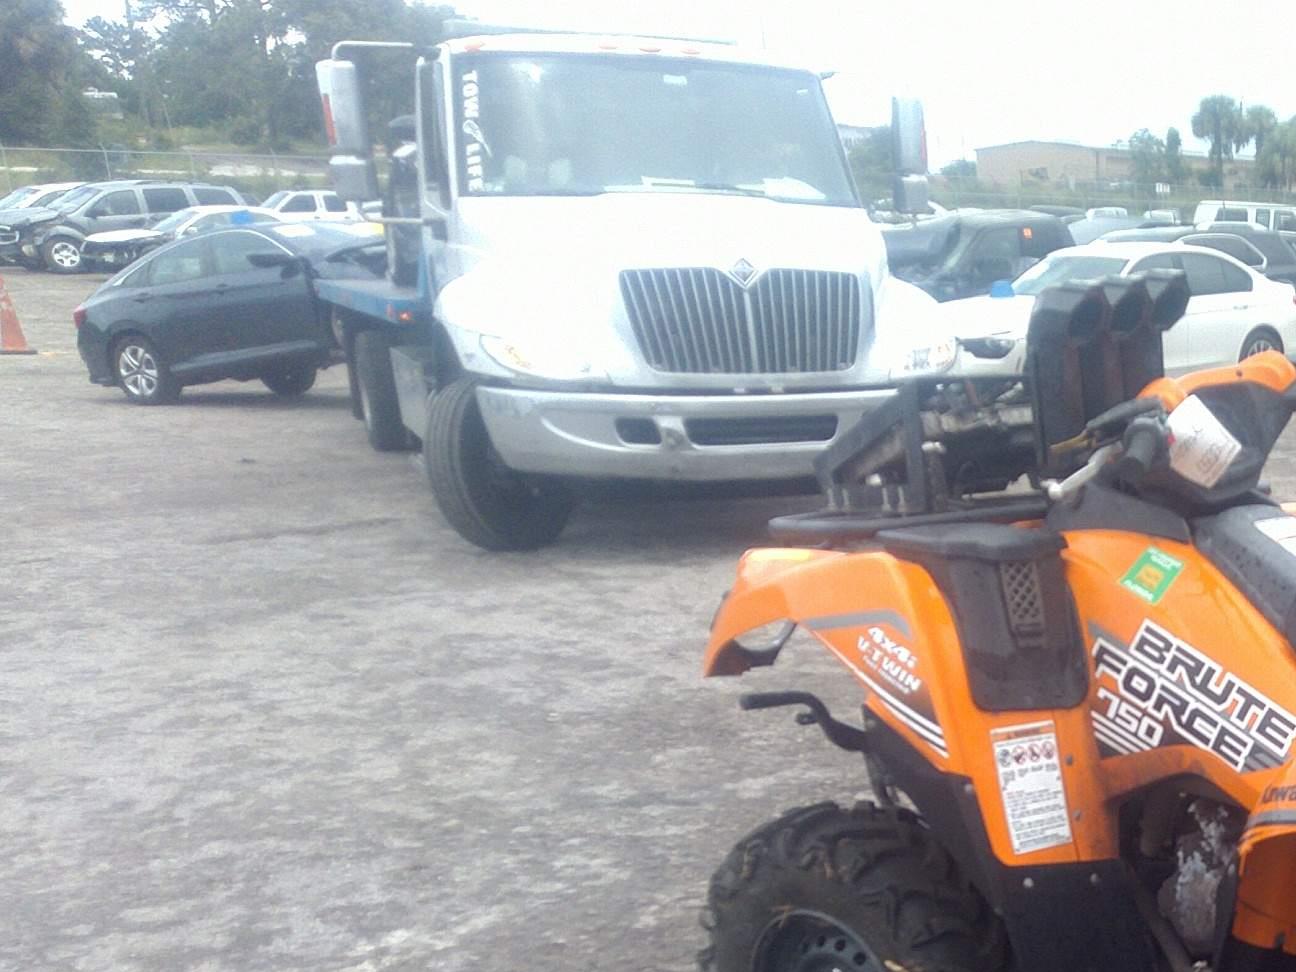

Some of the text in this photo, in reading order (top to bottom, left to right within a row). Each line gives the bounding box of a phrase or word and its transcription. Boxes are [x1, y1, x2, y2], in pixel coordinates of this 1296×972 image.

[462, 70, 480, 118] TOW
[1092, 637, 1254, 772] FORCE
[1097, 687, 1164, 747] 750
